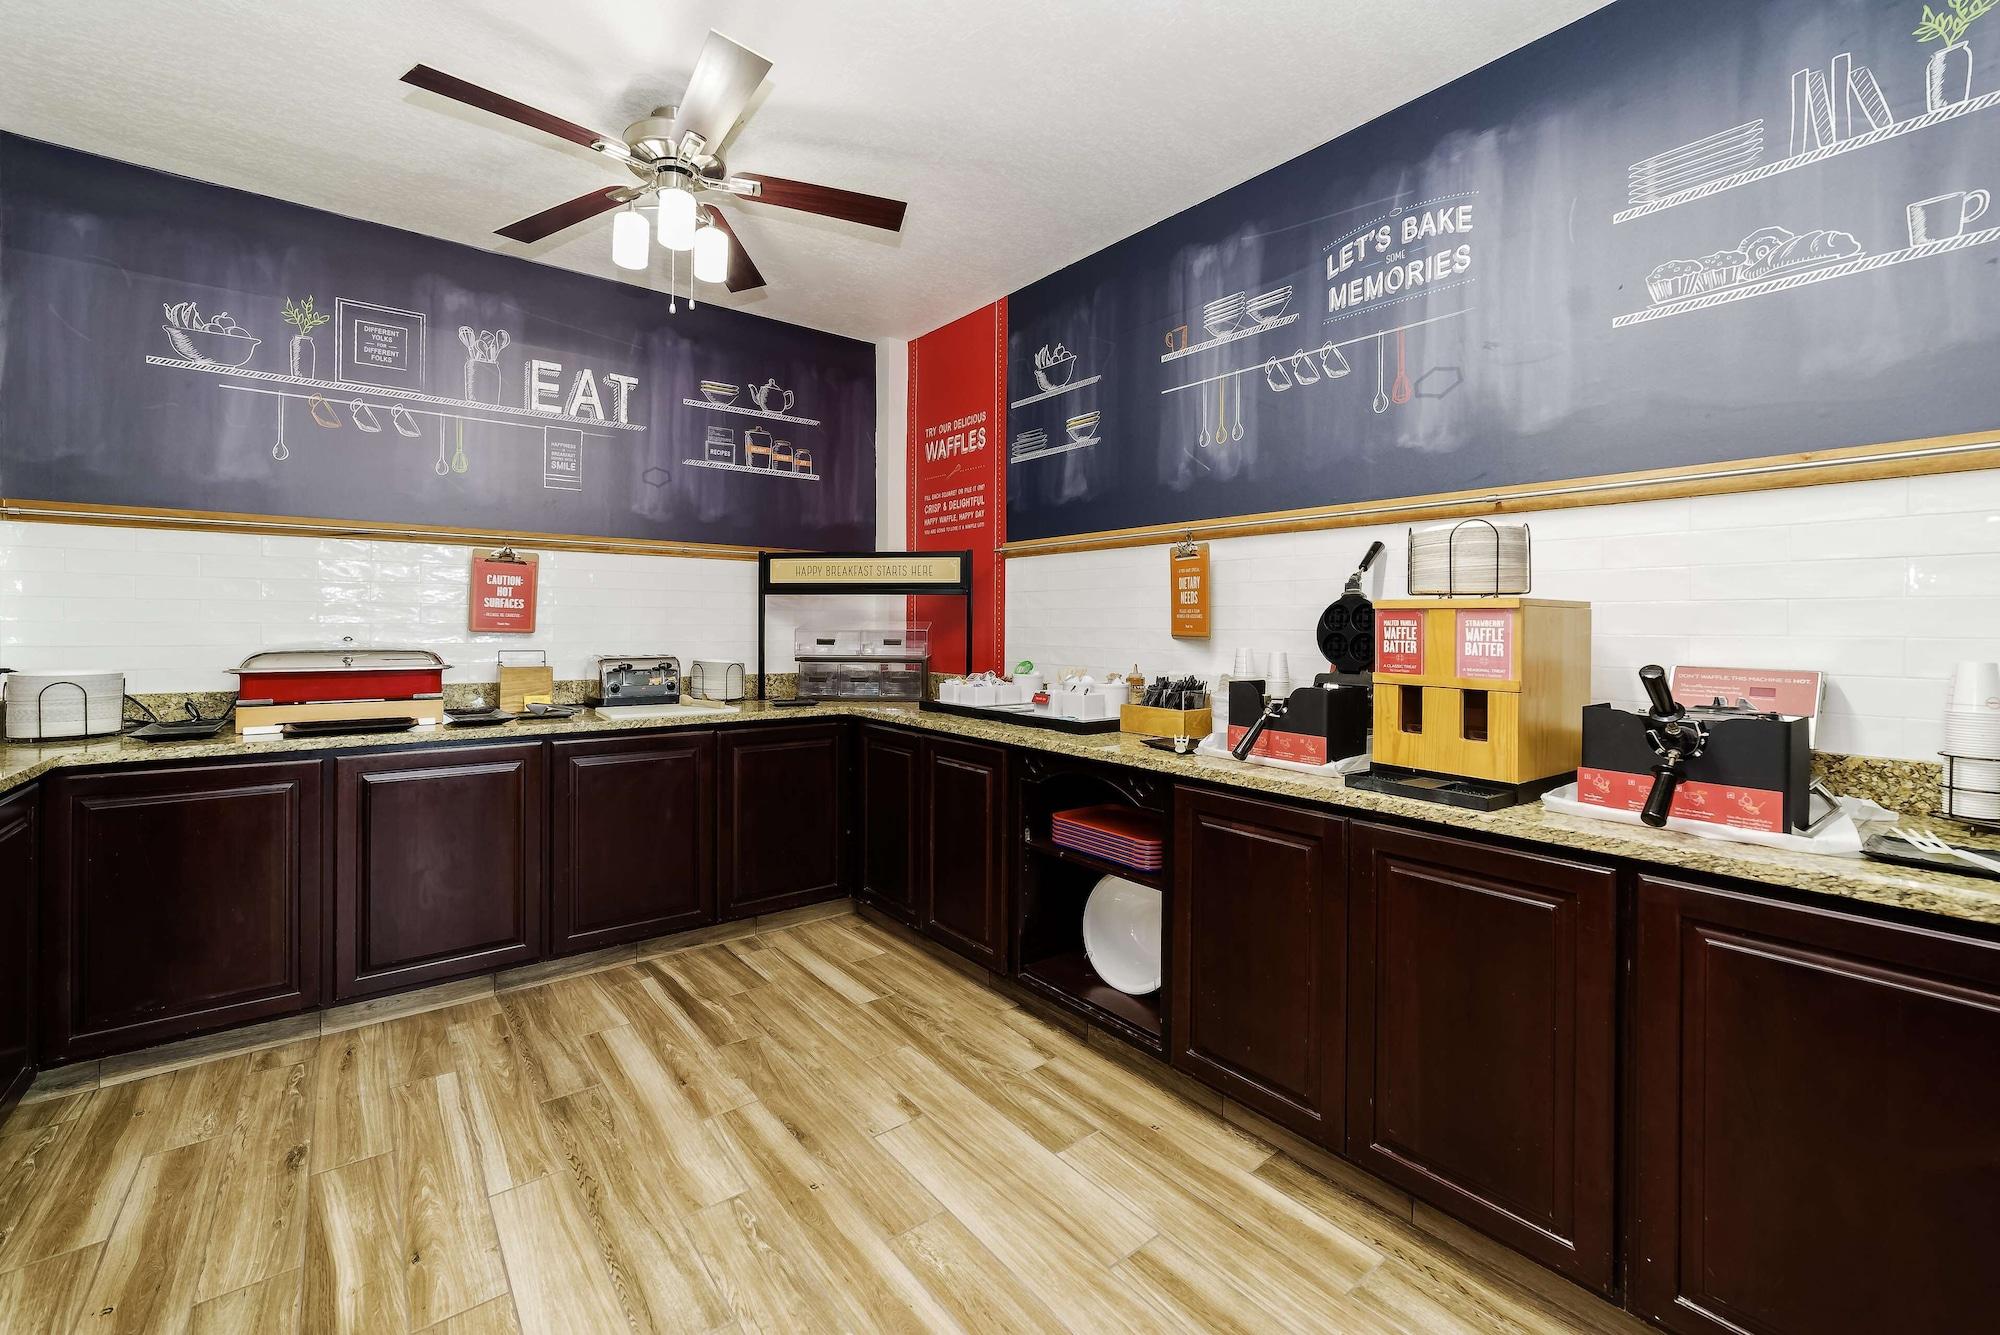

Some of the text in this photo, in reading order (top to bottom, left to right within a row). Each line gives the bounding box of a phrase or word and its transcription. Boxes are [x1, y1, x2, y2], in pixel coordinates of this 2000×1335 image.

[1326, 205, 1473, 280] LET'S BAKE
[1385, 249, 1406, 264] SOME
[1328, 244, 1471, 312] MEMORIES
[363, 325, 399, 337] DIFFERENT
[371, 334, 393, 343] YOLKS
[363, 346, 399, 357] DIFFERENT
[371, 354, 392, 363] FOLKS
[524, 359, 639, 424] EAT
[925, 411, 987, 438] TRY OUR DELICIOUS
[925, 427, 987, 463] WAFFLES
[710, 448, 731, 457] RECIPES
[551, 460, 576, 471] SMILE
[924, 495, 985, 515] CRISP & DELIGHTFUL
[924, 517, 938, 526] HAPPY
[958, 511, 974, 521] HAPPY
[795, 565, 933, 577] HAPPY BREAKFAST STARTS HERE
[486, 574, 524, 586] CAUTION:
[1178, 576, 1200, 590] DIETARY
[496, 586, 514, 597] HOT
[1180, 591, 1198, 605] NEEDS
[483, 597, 524, 609] SURFACES
[1384, 626, 1417, 640] WAFFLE
[1465, 628, 1504, 642] WAFFLE
[1383, 640, 1417, 654] BATTER
[1465, 642, 1504, 657] BATTER
